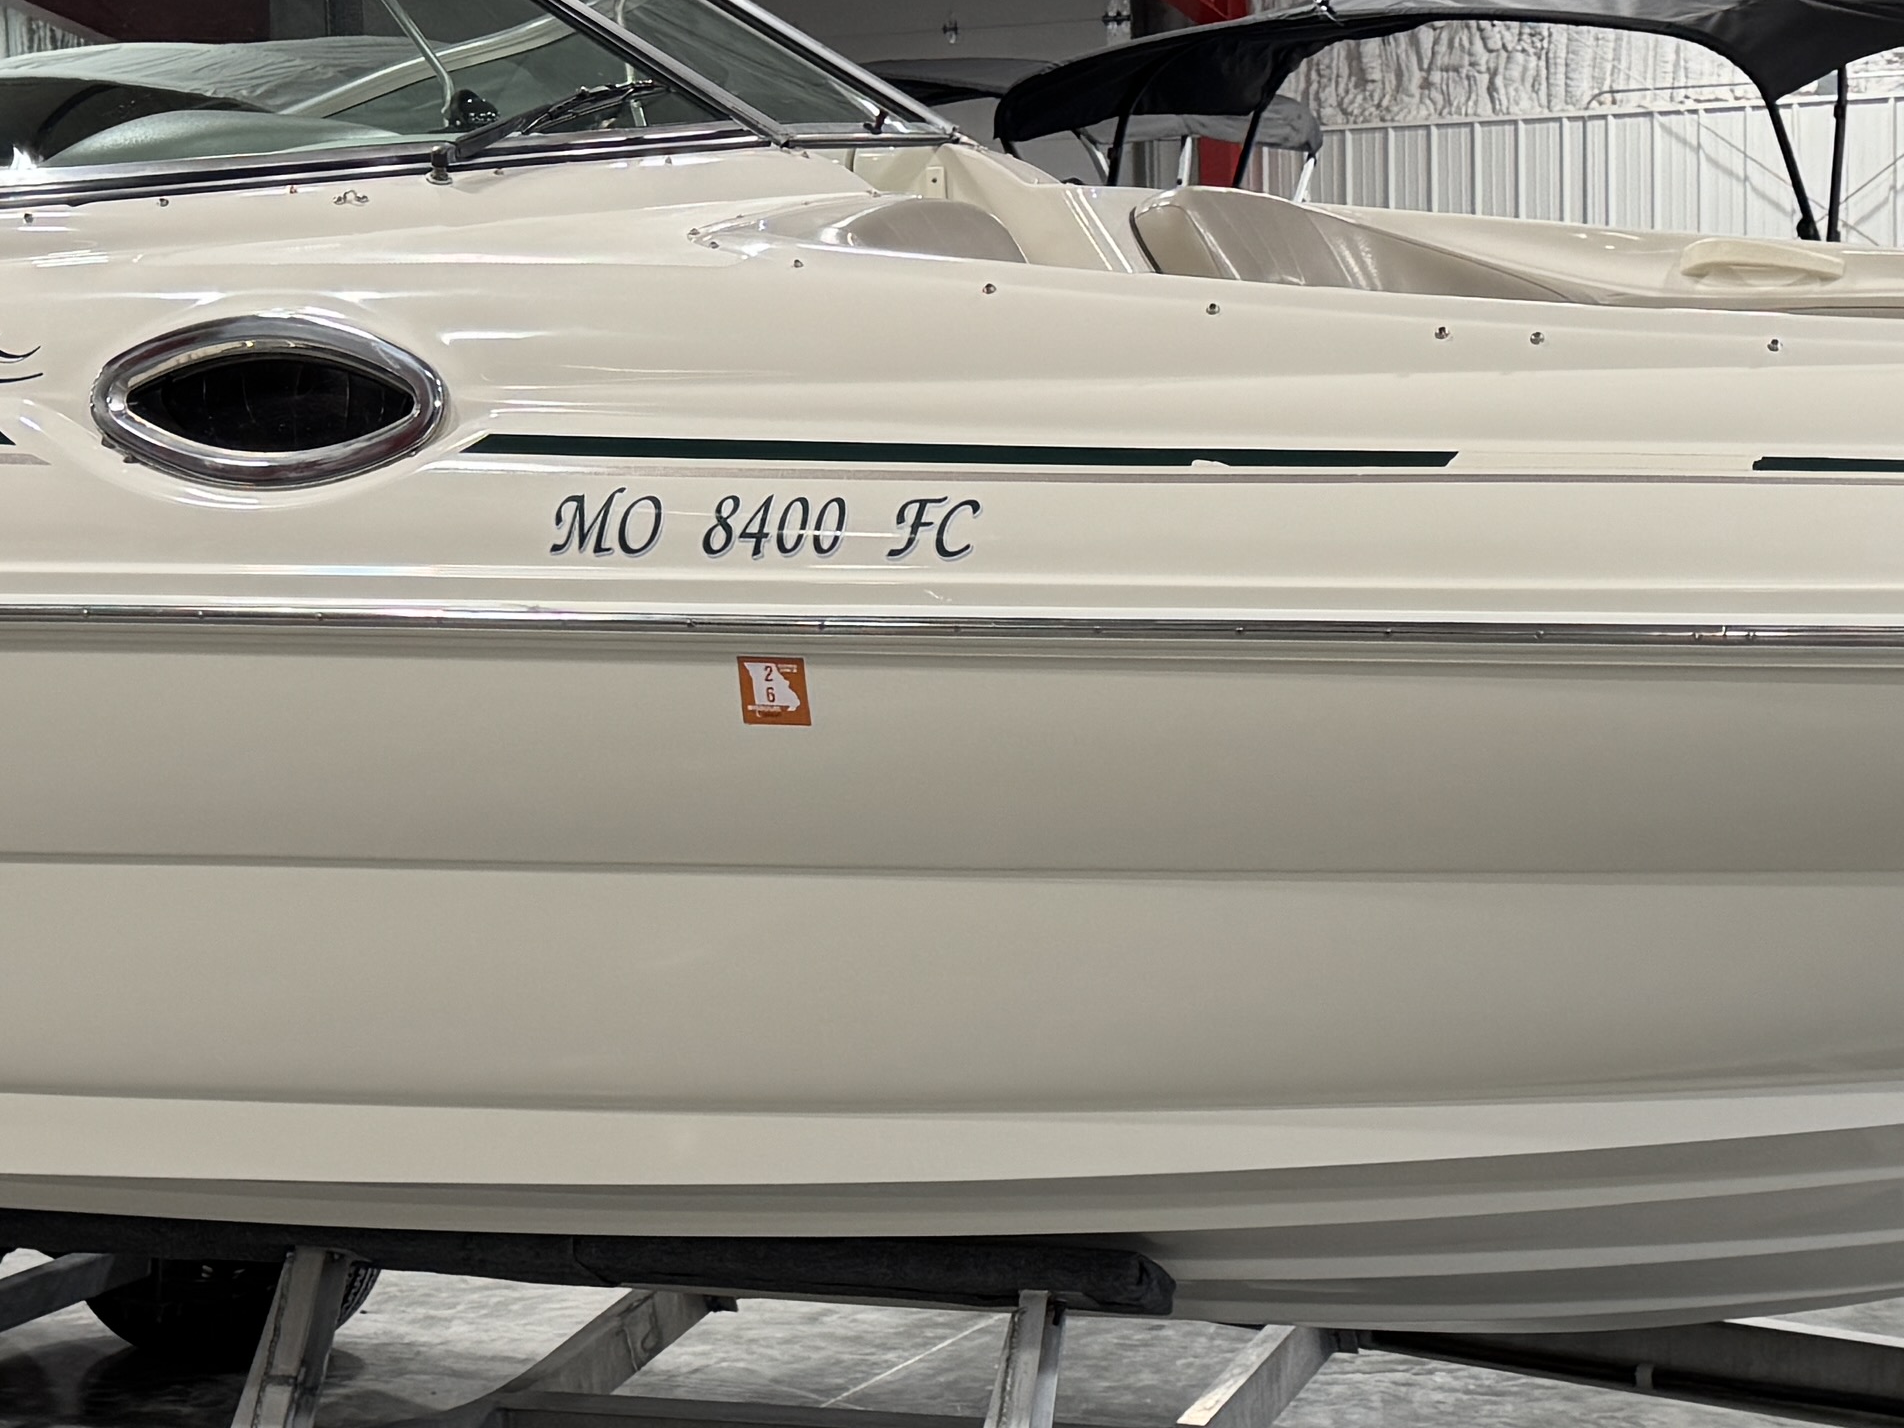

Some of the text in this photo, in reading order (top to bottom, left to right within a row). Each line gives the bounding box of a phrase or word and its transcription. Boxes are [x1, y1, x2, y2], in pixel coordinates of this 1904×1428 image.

[549, 486, 982, 559] MO 8400 FC
[764, 665, 774, 682] 2
[766, 686, 776, 703] 6
